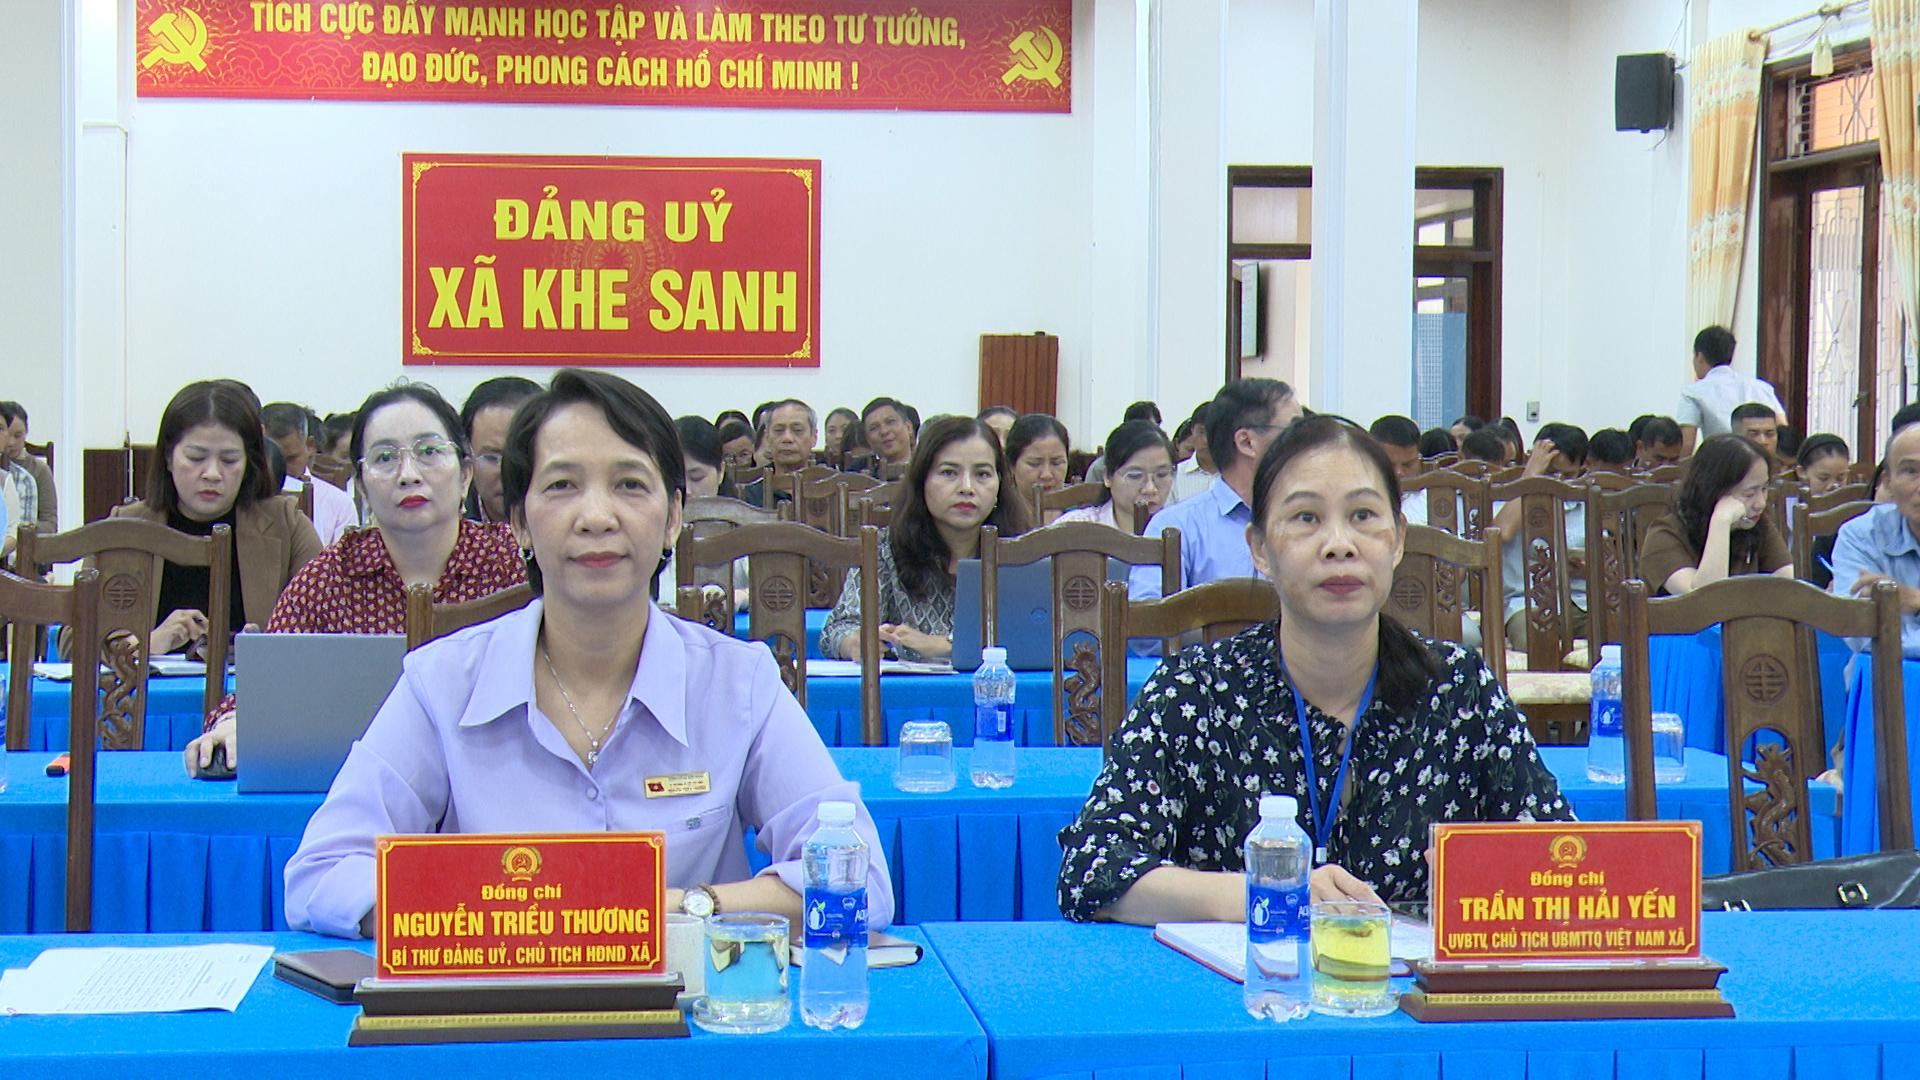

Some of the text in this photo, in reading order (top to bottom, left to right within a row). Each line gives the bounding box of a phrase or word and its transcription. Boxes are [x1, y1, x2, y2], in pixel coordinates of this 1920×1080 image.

[250, 0, 311, 33] TÍCH
[320, 1, 374, 40] CỰC
[445, 7, 524, 42] MẠNH
[535, 10, 586, 43] HỌC
[596, 4, 645, 45] TẬP
[654, 6, 688, 40] VÀ
[696, 6, 751, 42] LÀM
[761, 14, 824, 44] THEO
[834, 14, 867, 44] TƯ
[873, 8, 965, 49] TƯỞNG,
[362, 48, 858, 90] ĐẠO ĐỨC, PHONG CÁCH HỒ CHÍ MINH !
[494, 185, 732, 242] ĐẢNG UỶ
[428, 255, 796, 331] XÃ KHE SANH
[534, 884, 561, 899] chí
[1579, 872, 1604, 885] chí
[394, 903, 483, 937] NGUYỄN
[561, 908, 649, 933] THƯƠNG
[1532, 897, 1569, 925] THỊ
[1579, 888, 1619, 919] HẢI
[1628, 888, 1675, 918] YẾN
[393, 941, 650, 966] BÍ THƯ ĐẢNG UỶ, CHỦ TỊCH HĐND XÃ
[1492, 928, 1517, 948] CHỦ
[1521, 931, 1548, 952] TỊCH
[1552, 931, 1602, 948] UBMTTQ
[1636, 930, 1665, 946] NAM
[1669, 926, 1685, 946] XÃ
